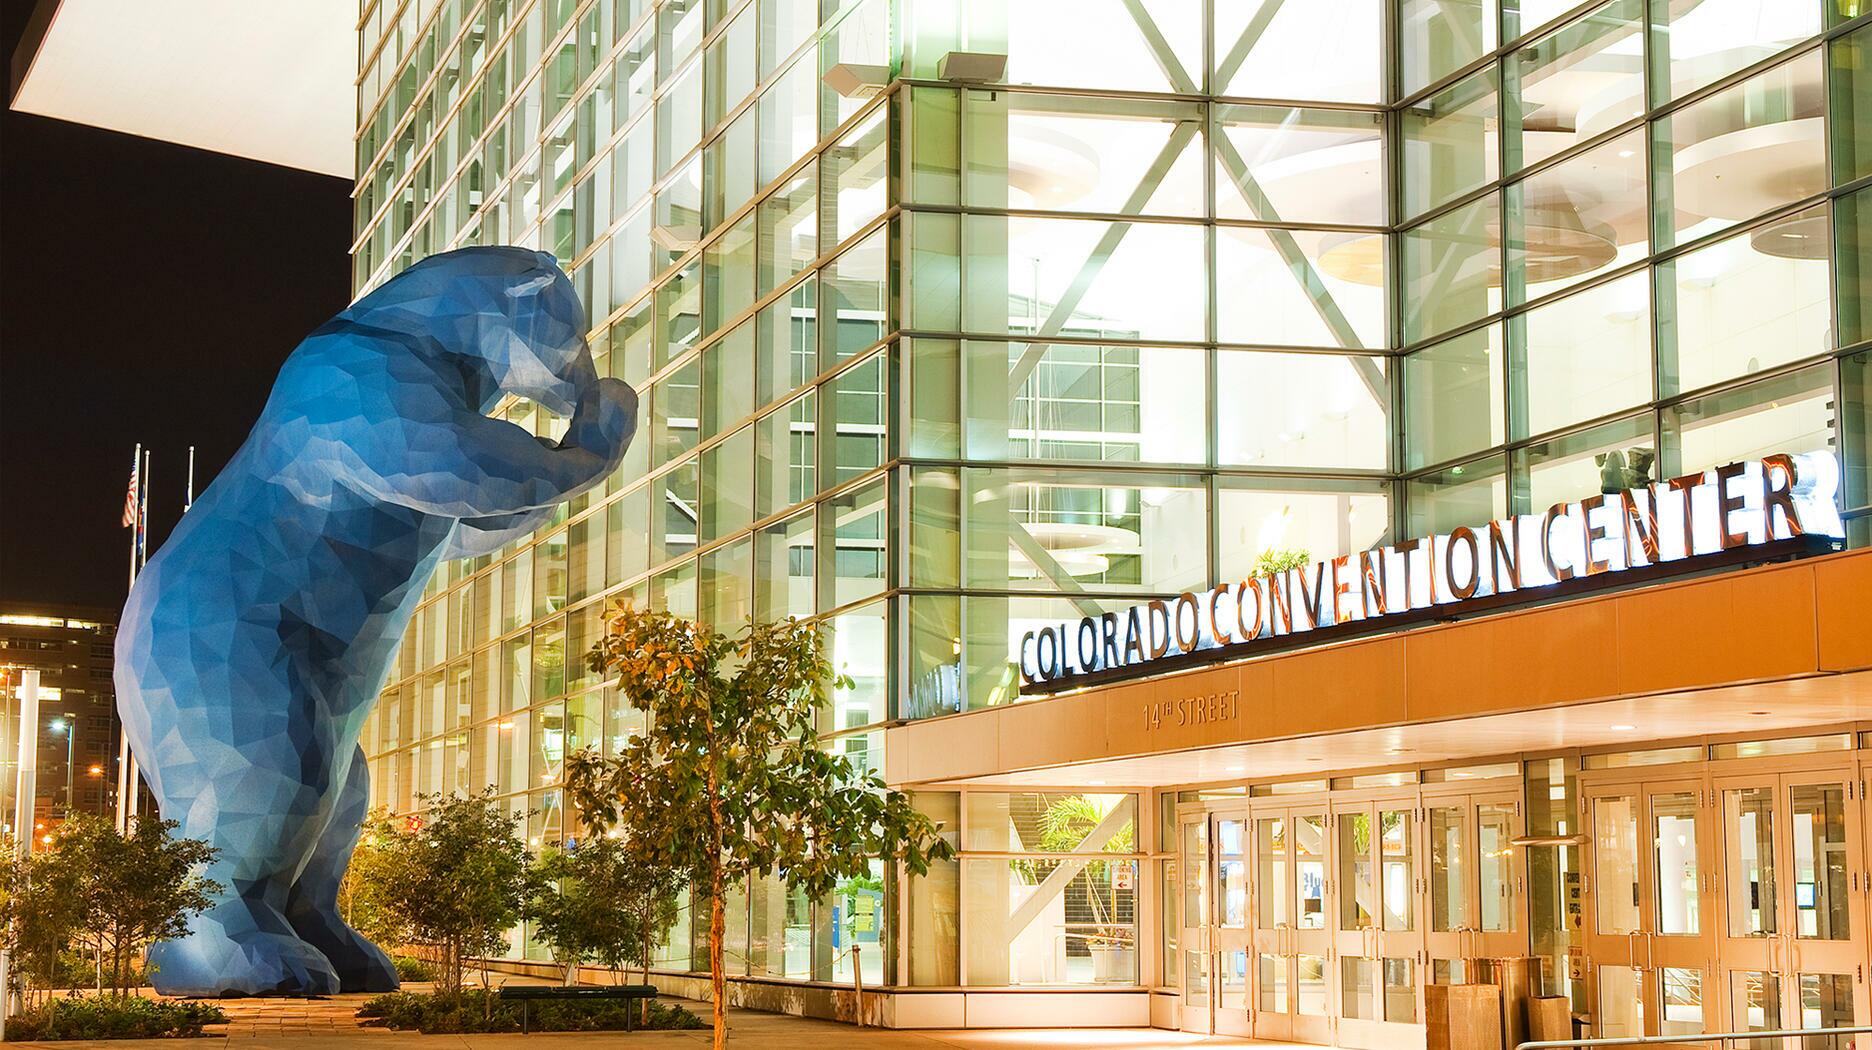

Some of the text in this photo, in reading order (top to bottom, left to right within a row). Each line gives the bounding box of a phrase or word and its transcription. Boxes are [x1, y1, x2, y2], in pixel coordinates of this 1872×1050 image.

[1021, 453, 1803, 684] COLORADO CONVENTION CENTER
[1143, 690, 1239, 730] 14TH STREET
